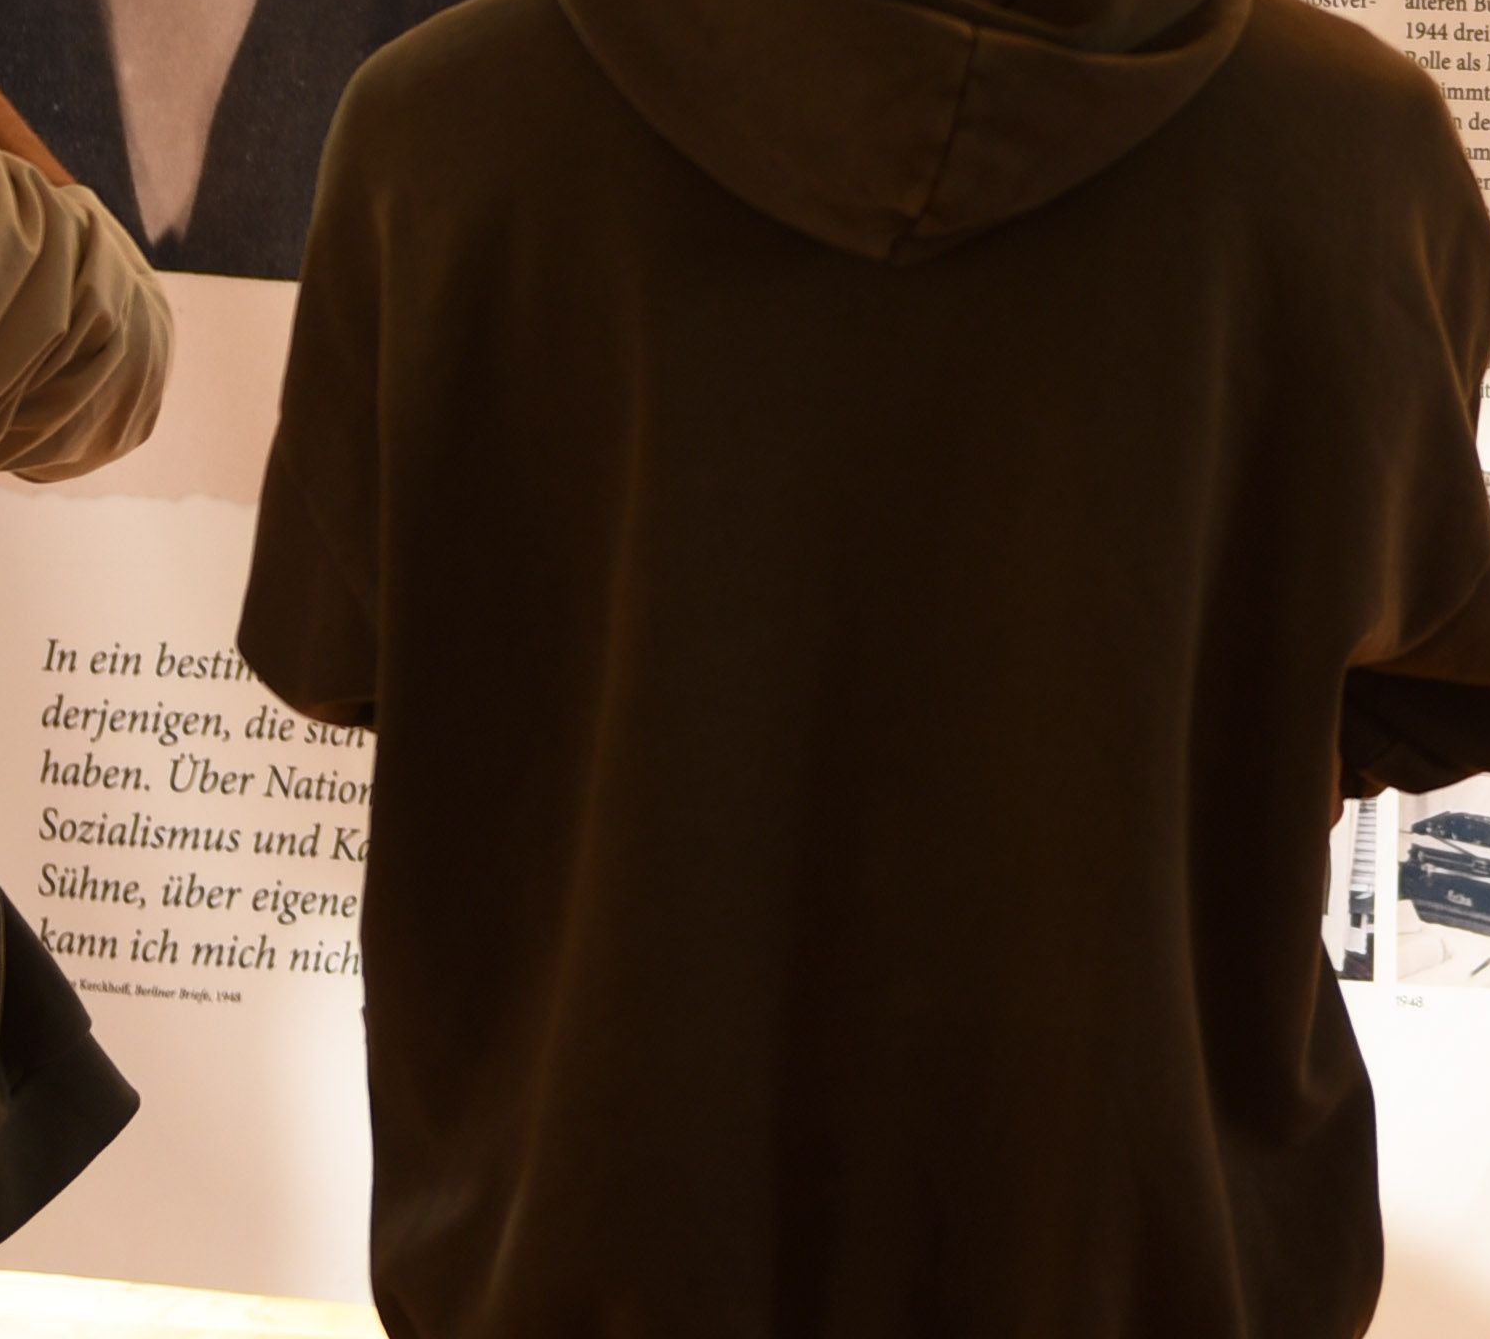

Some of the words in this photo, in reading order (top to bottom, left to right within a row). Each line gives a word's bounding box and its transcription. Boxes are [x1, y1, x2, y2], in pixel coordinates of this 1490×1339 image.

[1407, 22, 1448, 40] 1944
[1454, 22, 1490, 42] drei
[43, 639, 77, 673] In
[90, 643, 141, 676] ein
[42, 694, 231, 746] derjenigen,
[245, 704, 295, 741] die
[40, 749, 150, 791] haben.
[170, 753, 255, 795] Über
[263, 764, 372, 806] Nation
[39, 807, 241, 853] Sozialismus
[254, 823, 321, 858] und
[38, 863, 146, 909] Sühne,
[162, 873, 242, 910] über
[252, 880, 356, 925] eigene
[37, 918, 117, 960] kann
[131, 928, 178, 964] ich
[192, 934, 275, 970] mich
[290, 941, 358, 973] nich
